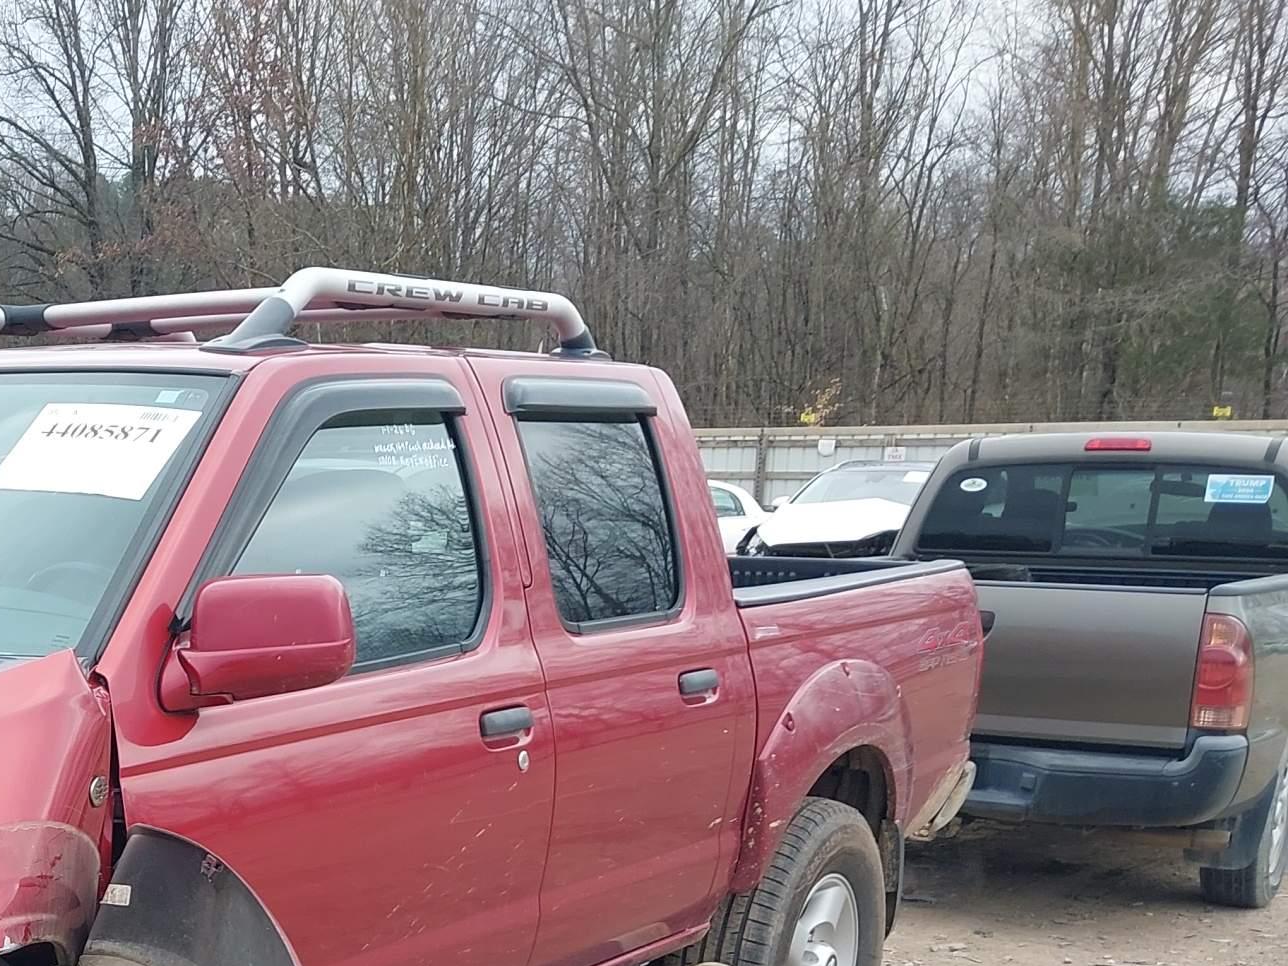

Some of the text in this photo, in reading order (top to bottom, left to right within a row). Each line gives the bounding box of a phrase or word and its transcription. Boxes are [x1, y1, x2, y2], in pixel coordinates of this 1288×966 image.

[347, 279, 549, 312] CREW CAB
[41, 422, 163, 443] 44085871
[1229, 478, 1267, 488] TRUMP
